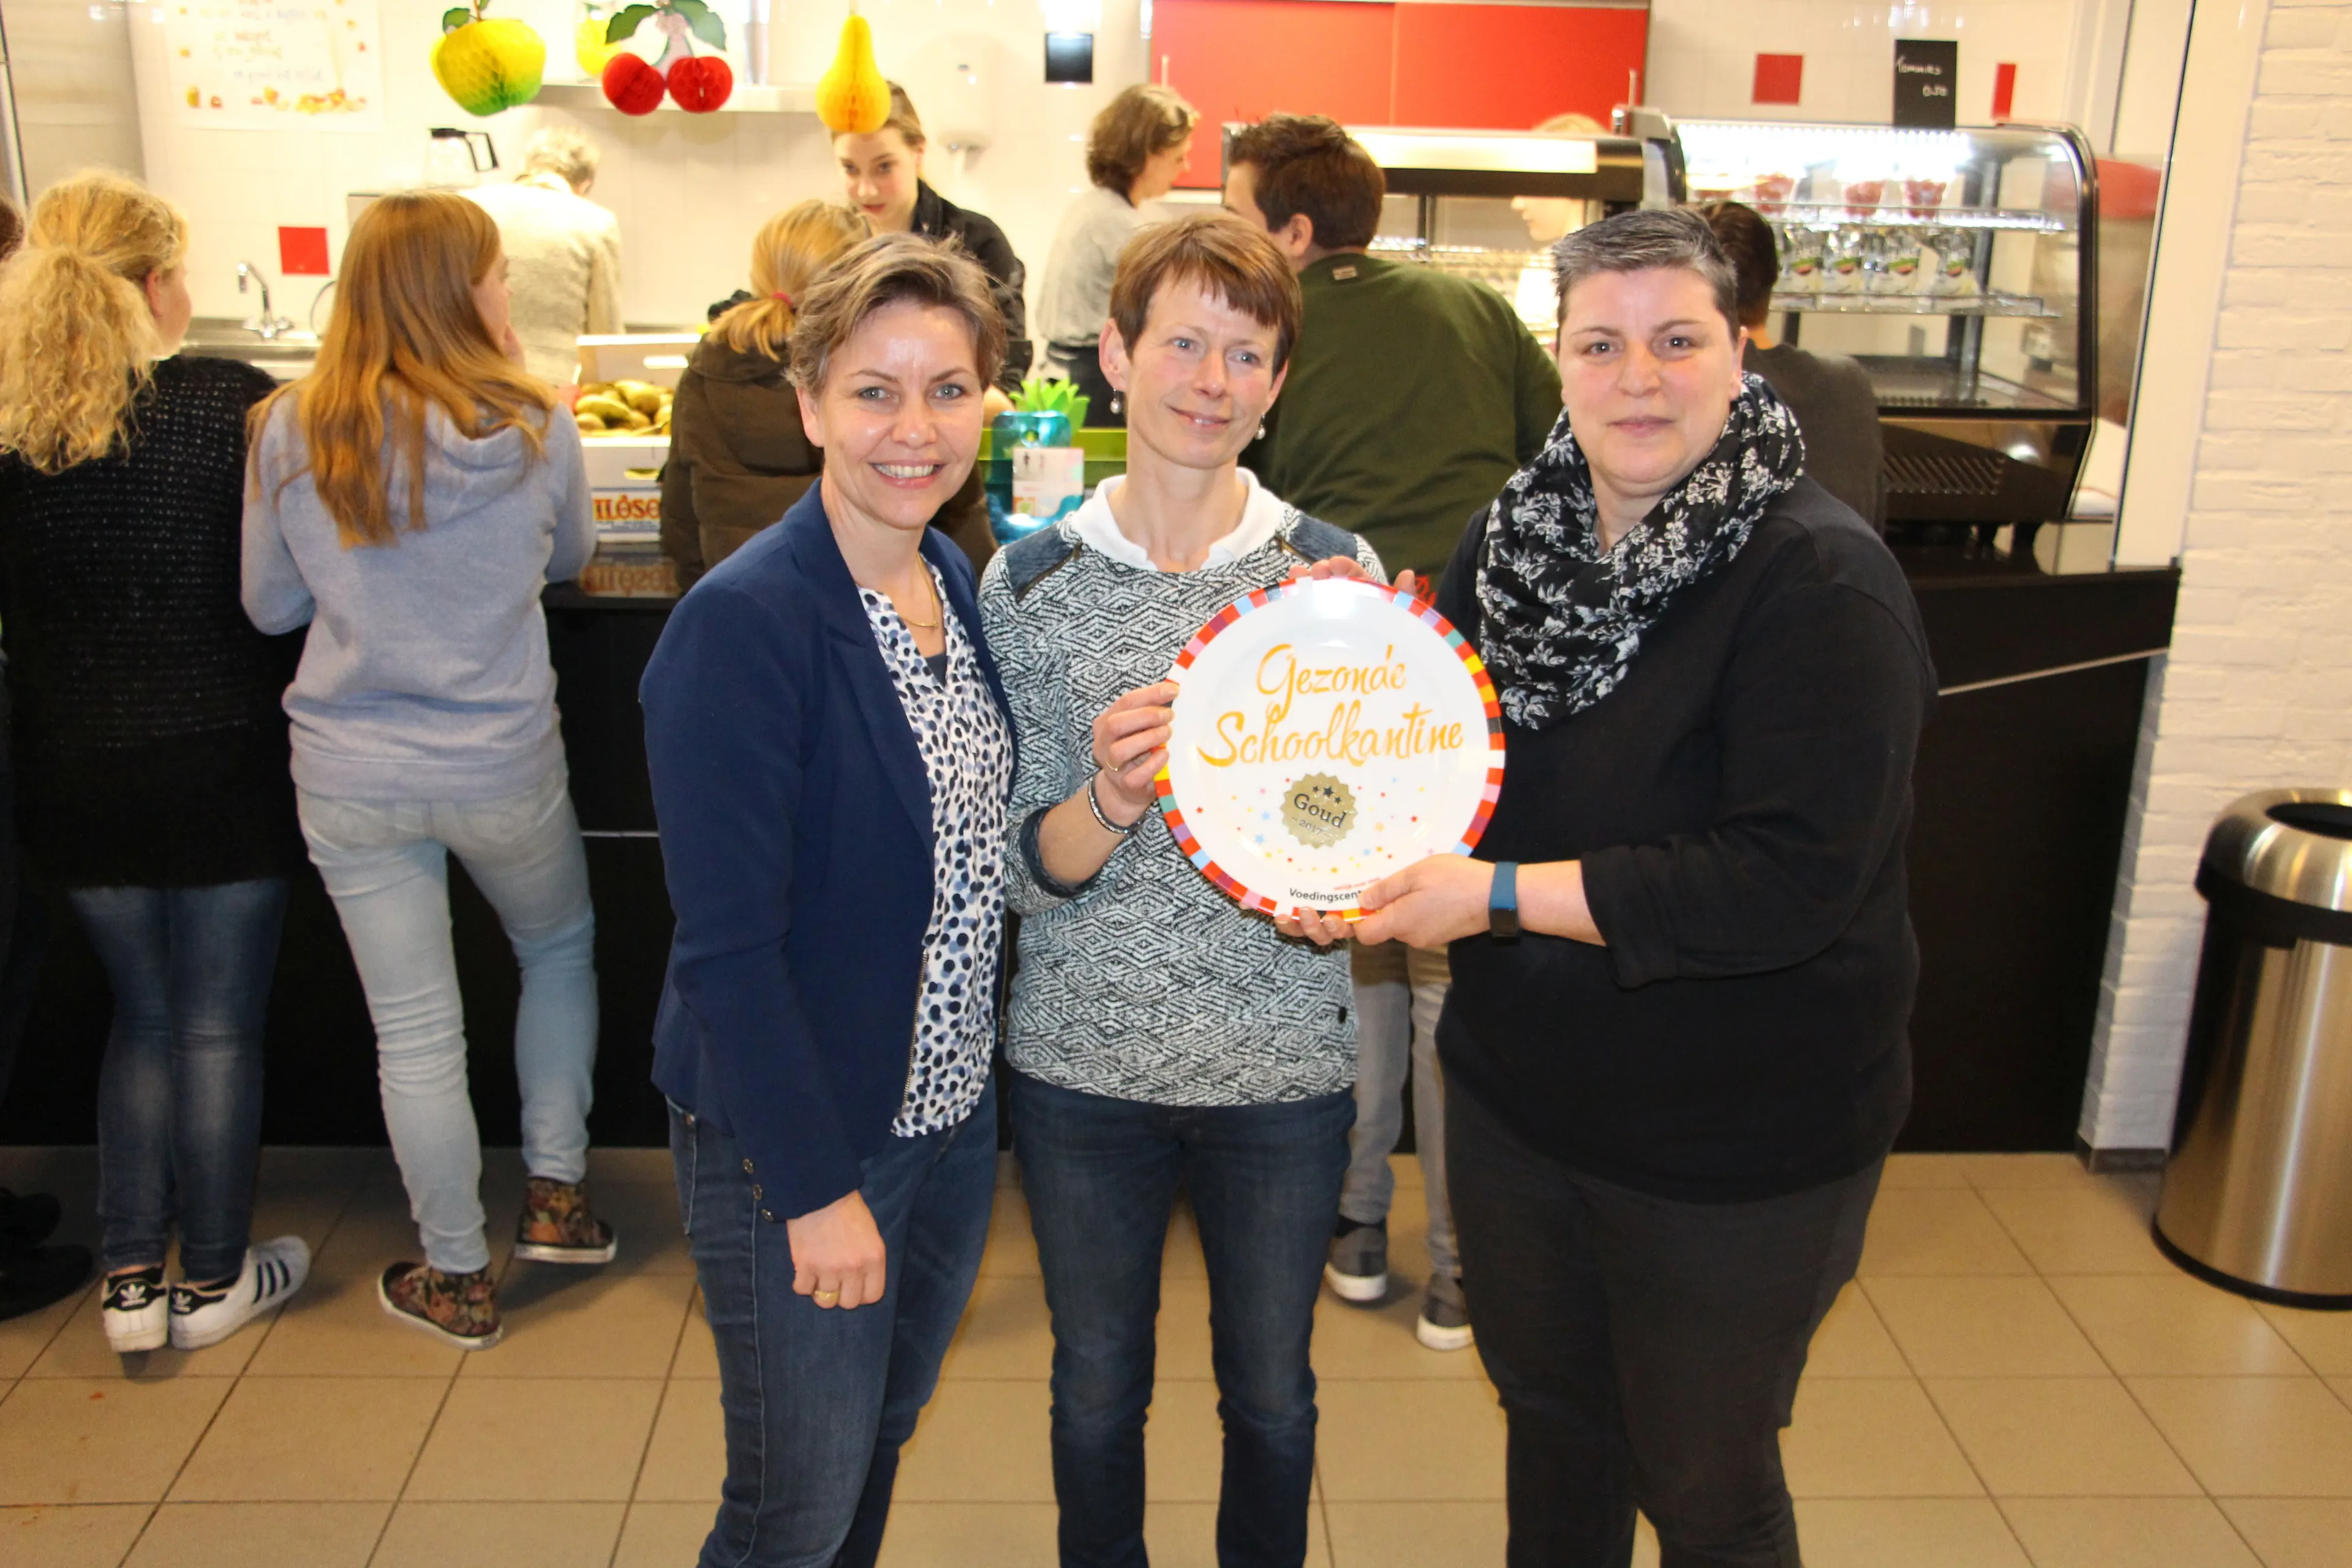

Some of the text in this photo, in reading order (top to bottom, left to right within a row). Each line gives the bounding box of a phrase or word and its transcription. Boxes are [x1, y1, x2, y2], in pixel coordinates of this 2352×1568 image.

[1256, 643, 1406, 725] Gezonde
[1196, 699, 1463, 767] Schoolkantine
[1294, 793, 1347, 828] Goud
[1298, 820, 1323, 835] 2017
[1289, 888, 1362, 903] Voedingscen
